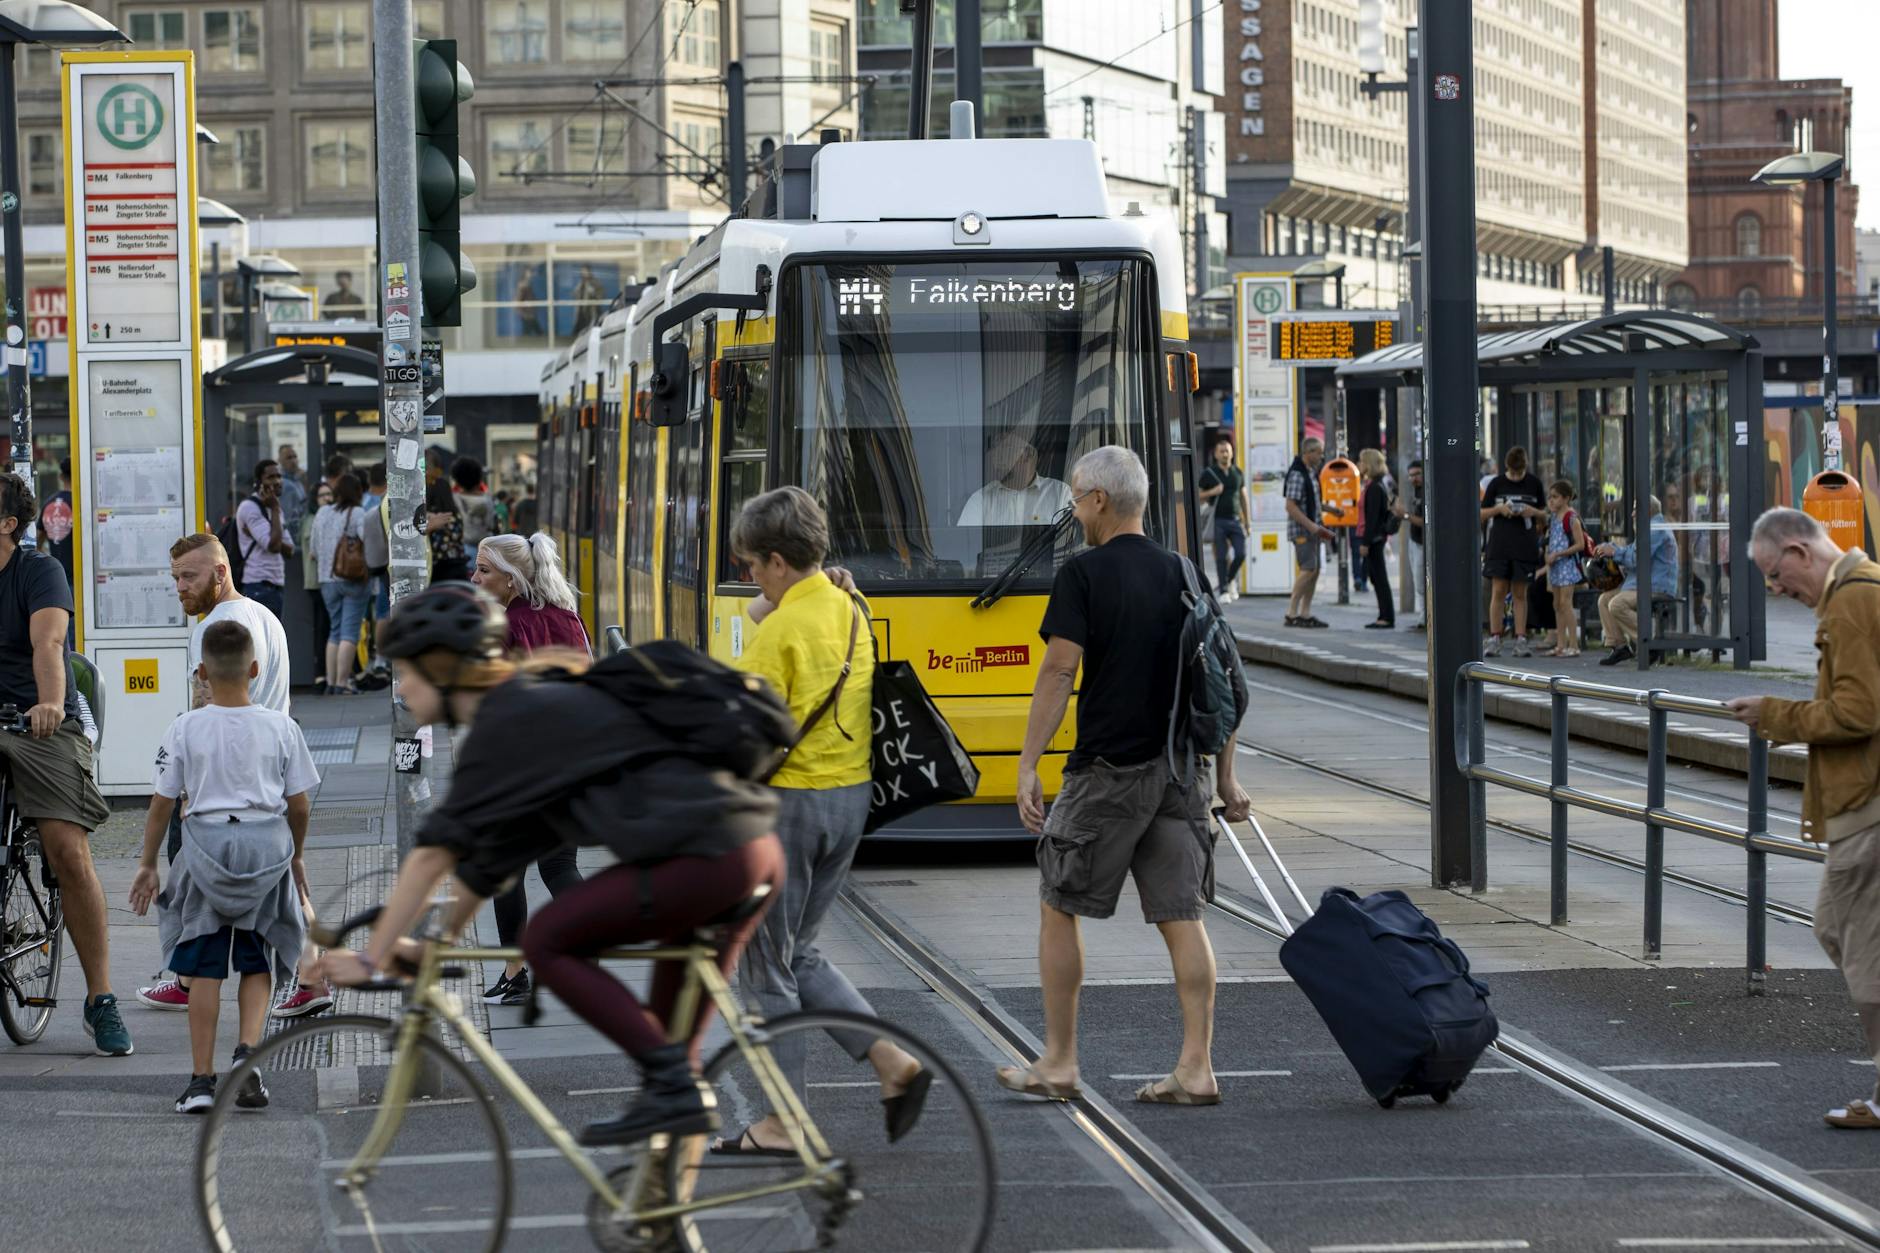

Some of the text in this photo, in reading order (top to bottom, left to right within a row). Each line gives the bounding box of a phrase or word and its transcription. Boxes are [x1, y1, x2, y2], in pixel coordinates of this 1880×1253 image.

[114, 98, 146, 135] H
[95, 172, 153, 182] M4 Falkenberg
[116, 211, 143, 219] Zingster
[96, 235, 109, 243] M5
[116, 242, 144, 250] Zingster
[97, 263, 155, 274] M6 Hellersdorf
[145, 271, 167, 279] Straße
[387, 286, 409, 299] LBS
[840, 277, 1075, 315] M4 Falkenberg
[102, 379, 137, 387] U-Bahnhof
[102, 387, 153, 396] Alexanderplatz
[1831, 518, 1857, 528] füttern
[927, 649, 1025, 670] be Berlin
[129, 675, 154, 690] BVG
